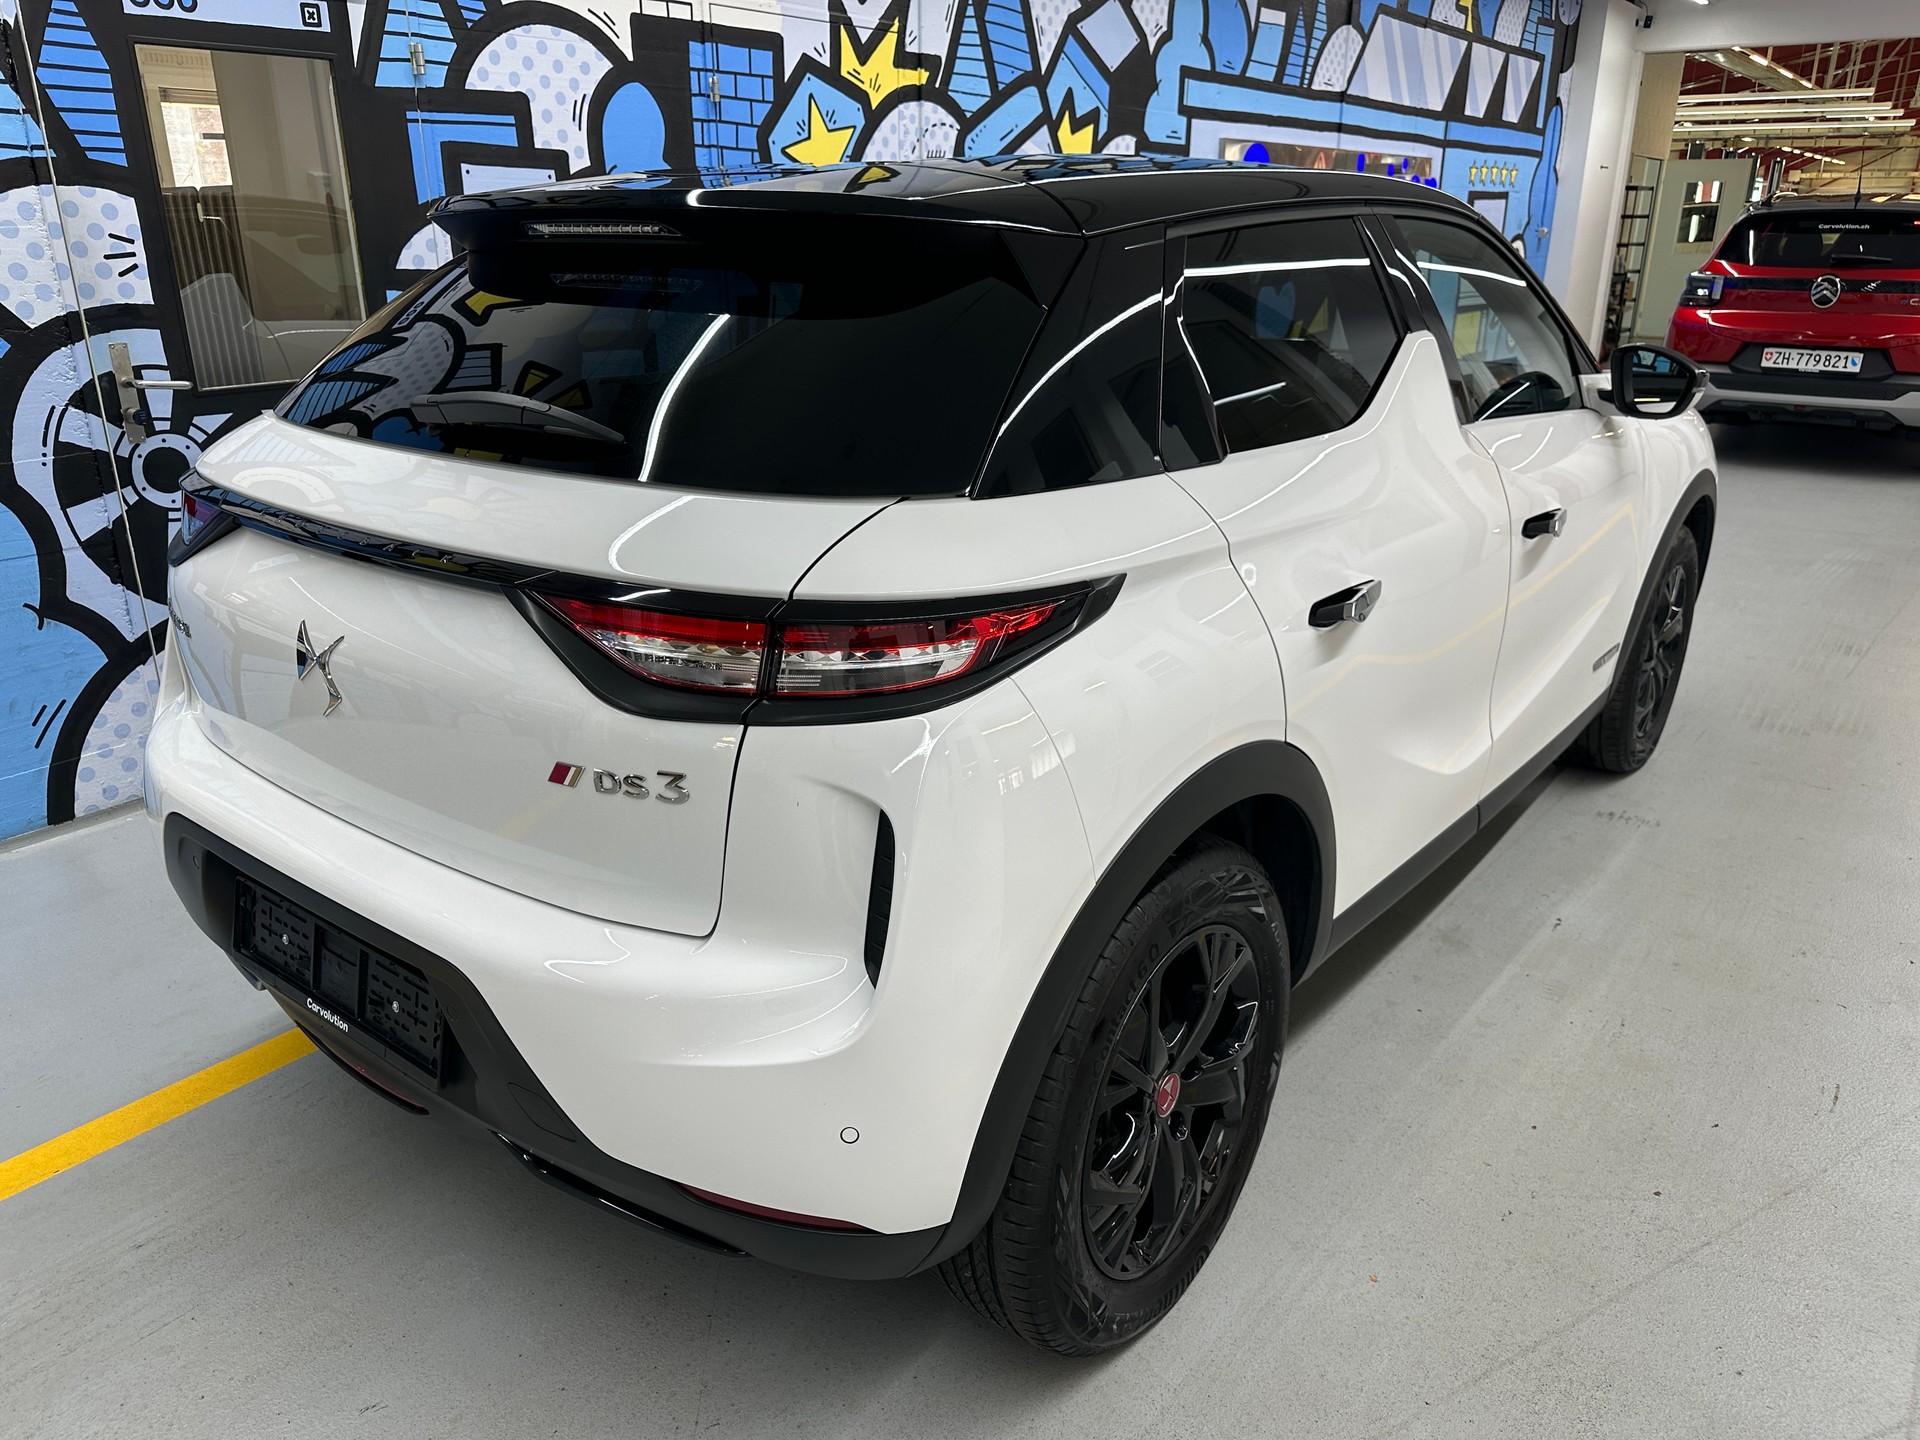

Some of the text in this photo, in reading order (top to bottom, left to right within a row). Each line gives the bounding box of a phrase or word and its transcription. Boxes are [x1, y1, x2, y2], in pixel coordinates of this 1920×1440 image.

[593, 767, 690, 805] DS 3
[306, 997, 349, 1033] Carvolution
